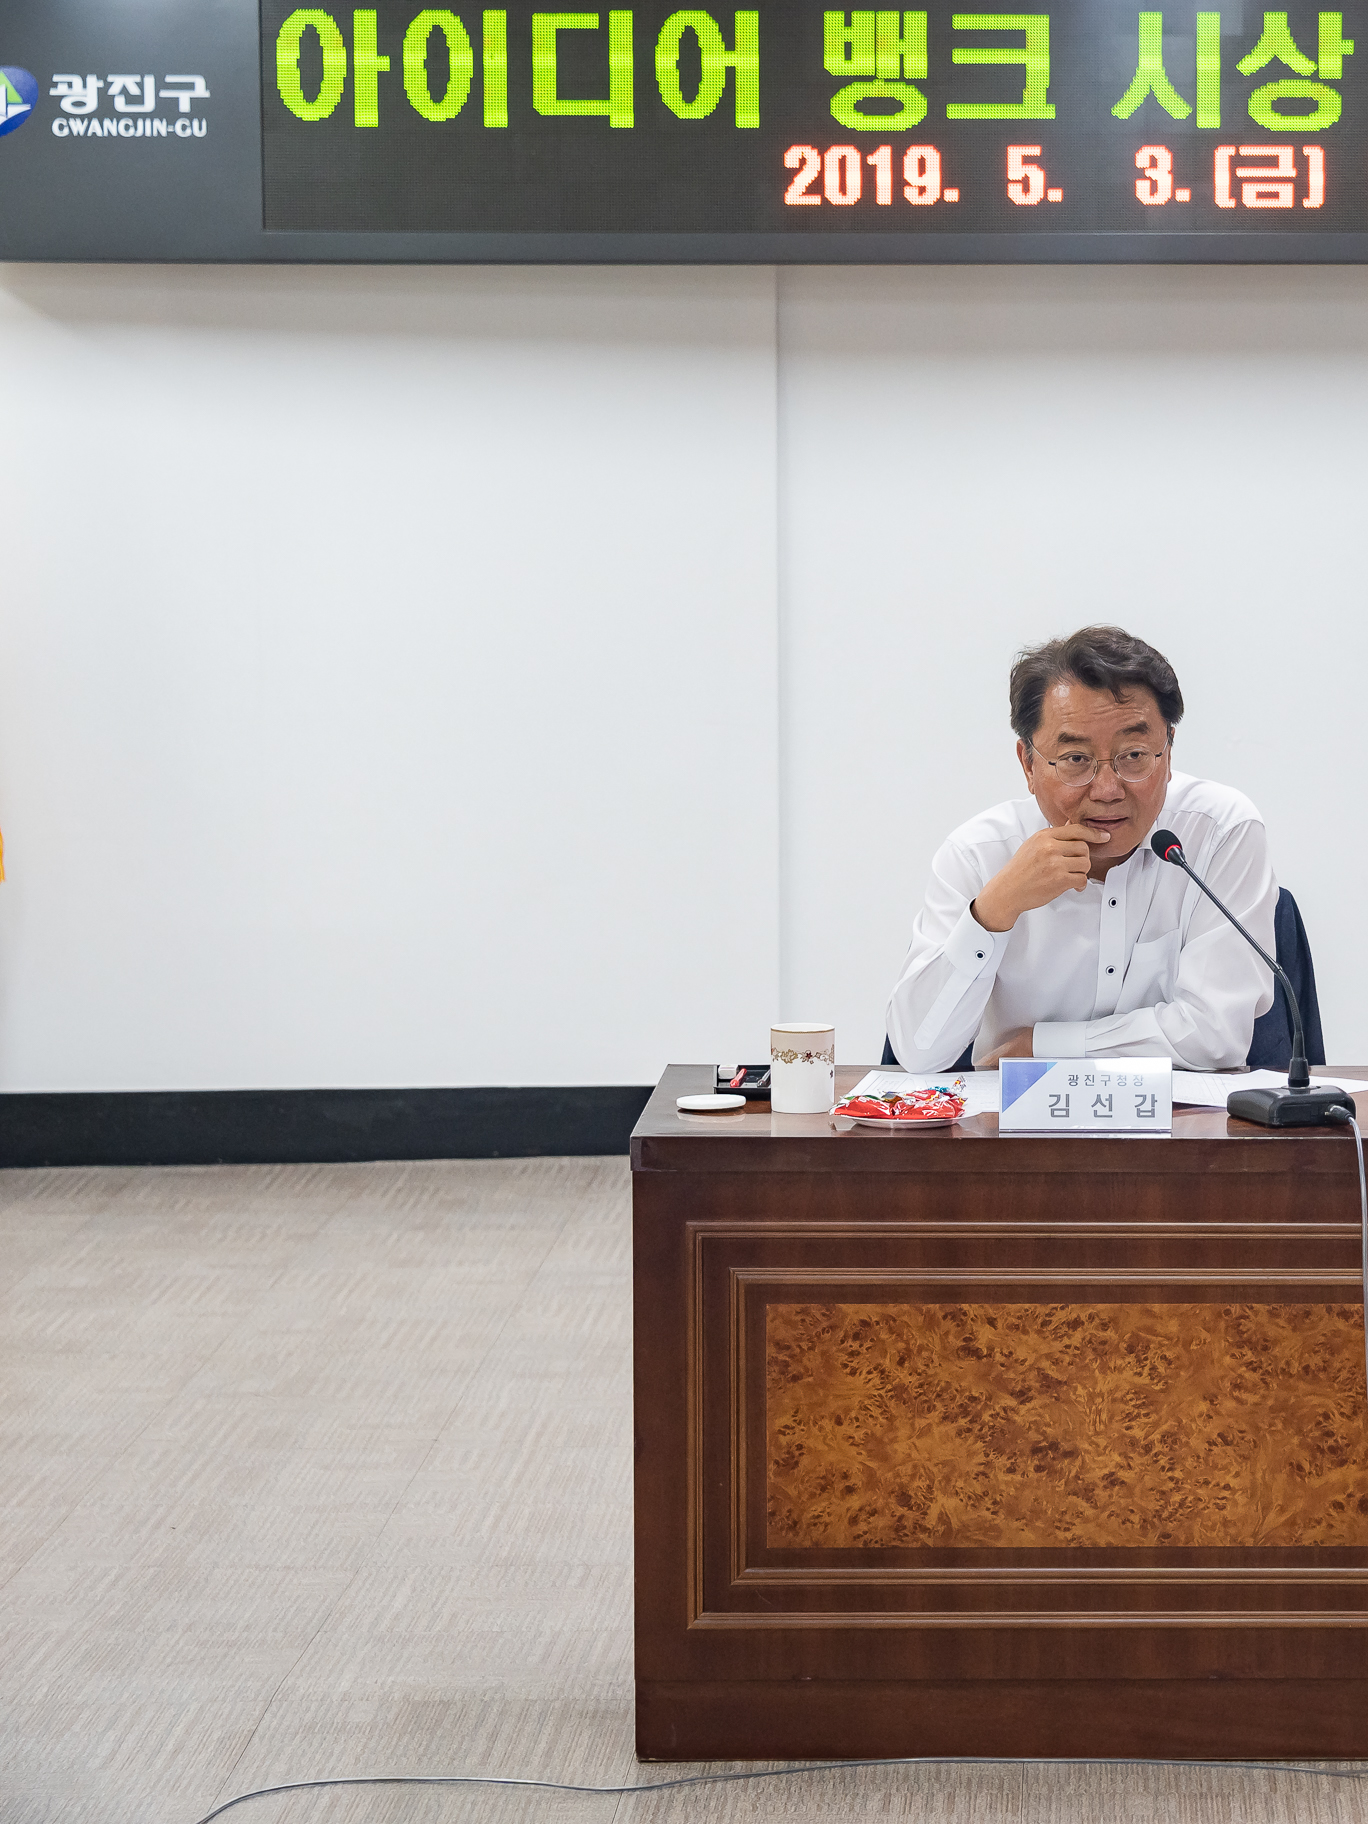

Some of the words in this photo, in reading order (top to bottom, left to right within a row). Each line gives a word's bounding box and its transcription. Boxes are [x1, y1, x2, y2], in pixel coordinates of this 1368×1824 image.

[276, 10, 762, 130] 아이디어
[824, 11, 1057, 132] 뱅크
[1111, 12, 1356, 132] 시상
[49, 73, 211, 115] 광진구
[51, 117, 208, 138] GWANGJIN-GU
[783, 145, 962, 207] 2019.
[1006, 145, 1065, 207] 5.
[1067, 1074, 1144, 1087] 광진구청장
